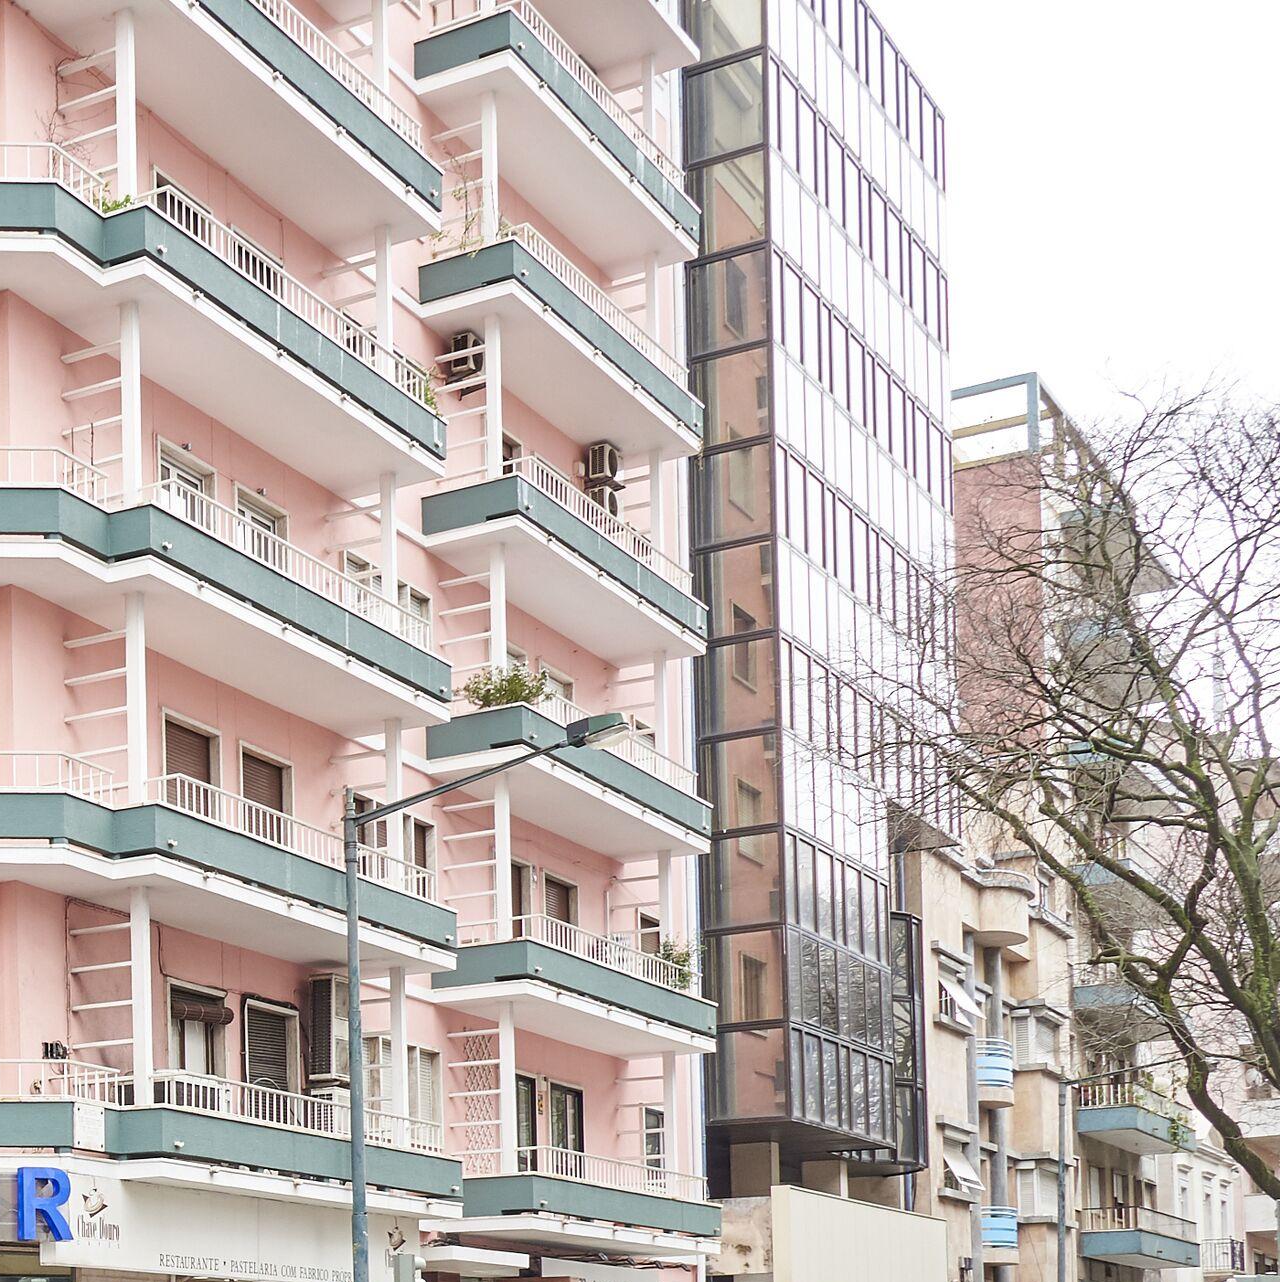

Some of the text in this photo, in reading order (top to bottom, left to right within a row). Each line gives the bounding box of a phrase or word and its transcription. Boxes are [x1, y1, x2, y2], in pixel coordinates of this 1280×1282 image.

[77, 1214, 97, 1239] Chave
[159, 1253, 220, 1272] RESTAURANTE
[230, 1260, 278, 1277] PASTELARIA
[280, 1264, 297, 1279] COM
[299, 1266, 329, 1282] FABRICO
